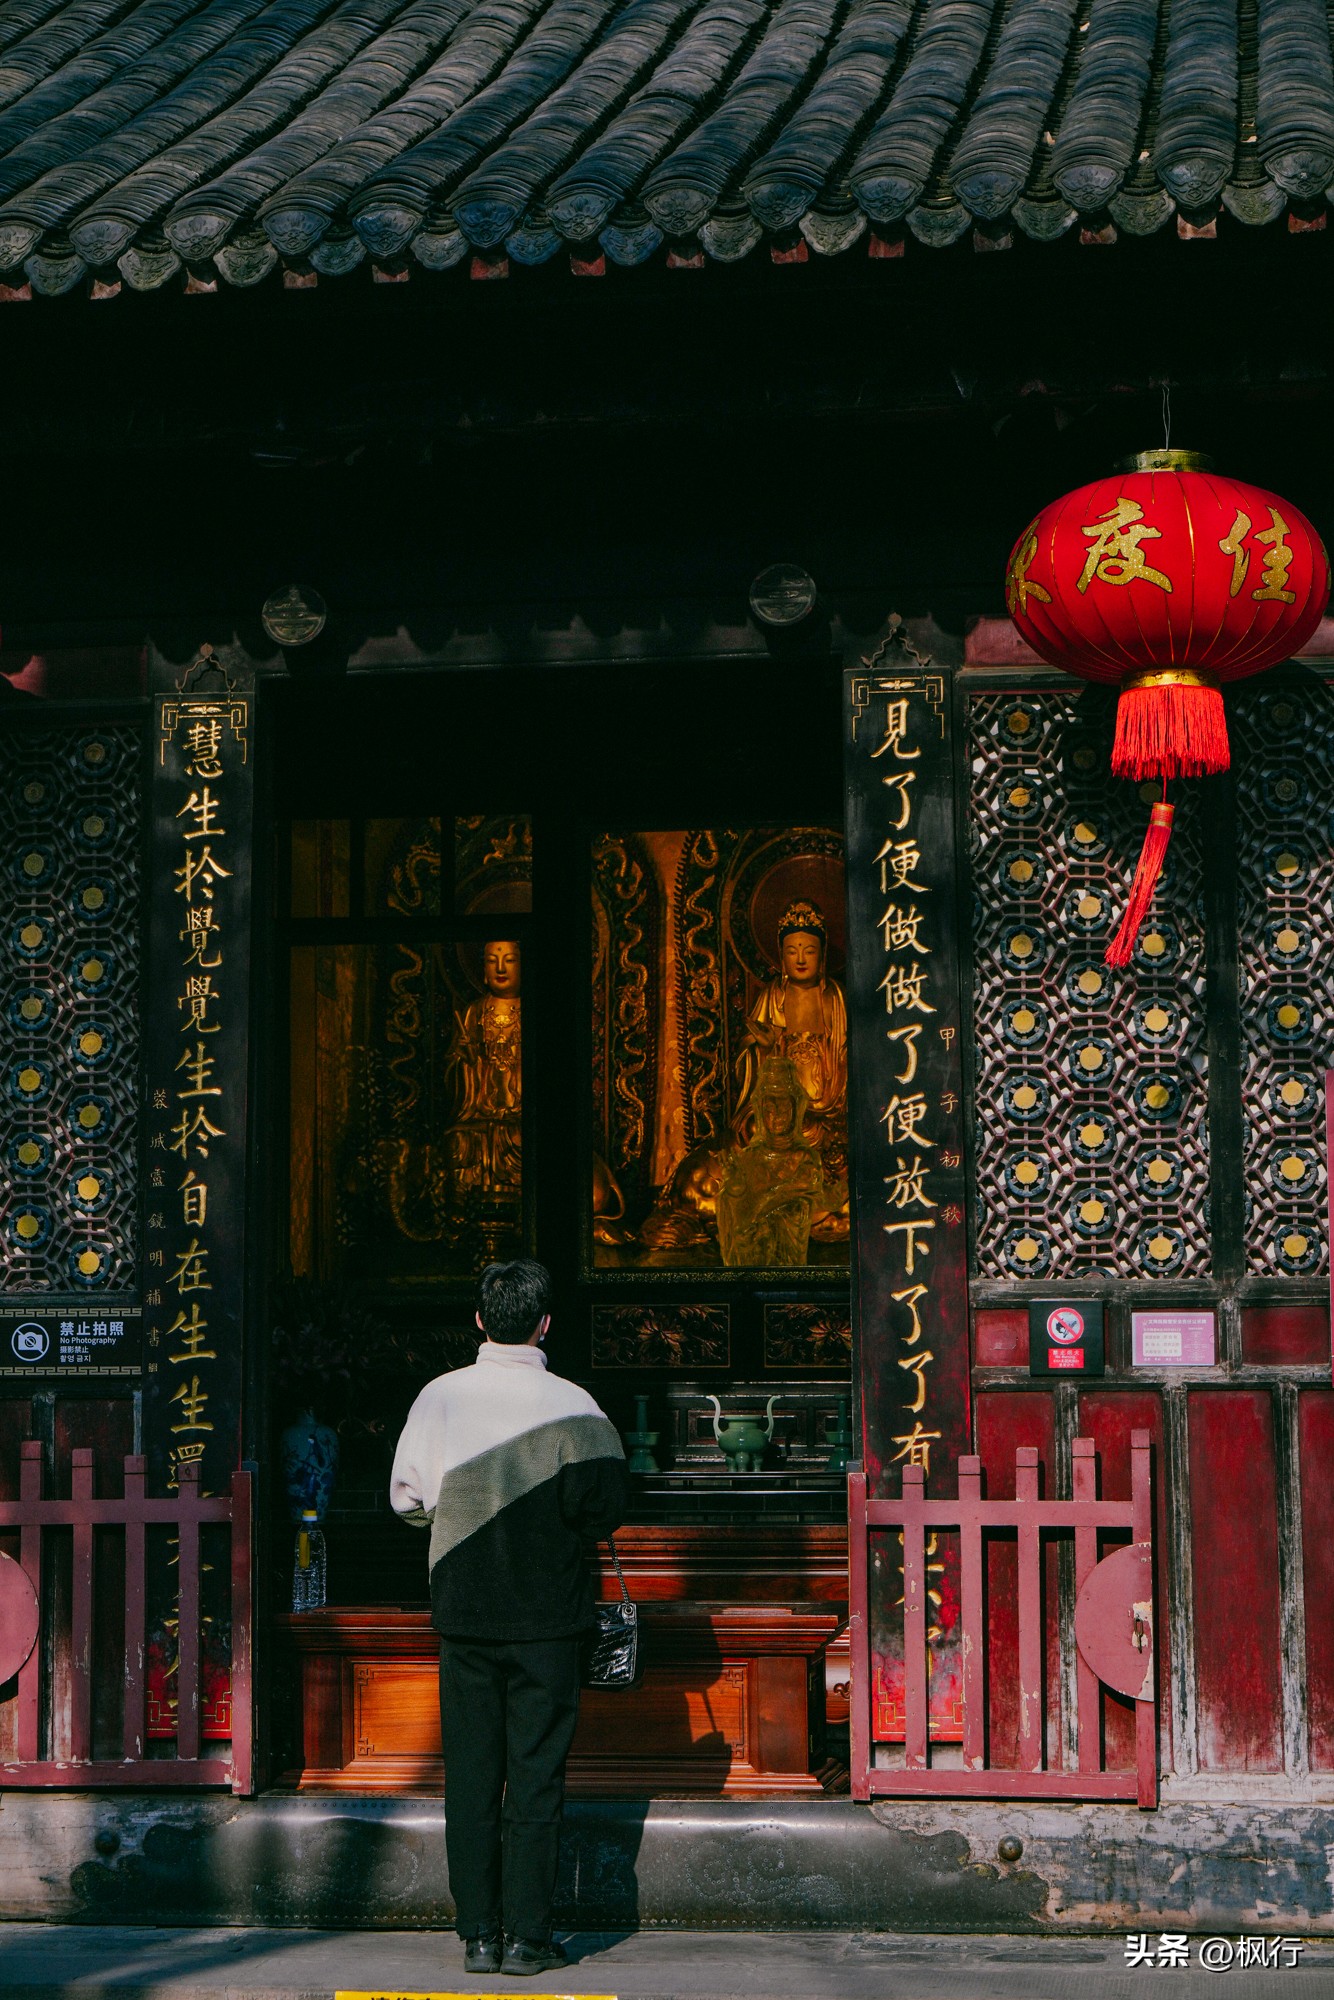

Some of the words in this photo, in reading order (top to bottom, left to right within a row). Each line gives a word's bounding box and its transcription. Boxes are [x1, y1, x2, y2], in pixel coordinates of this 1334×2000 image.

[939, 1028, 962, 1226] 甲子初秋
[871, 698, 941, 1678] 見了便做做了便放下了了有
[60, 1321, 124, 1336] 禁止拍照
[71, 1336, 117, 1345] Photography
